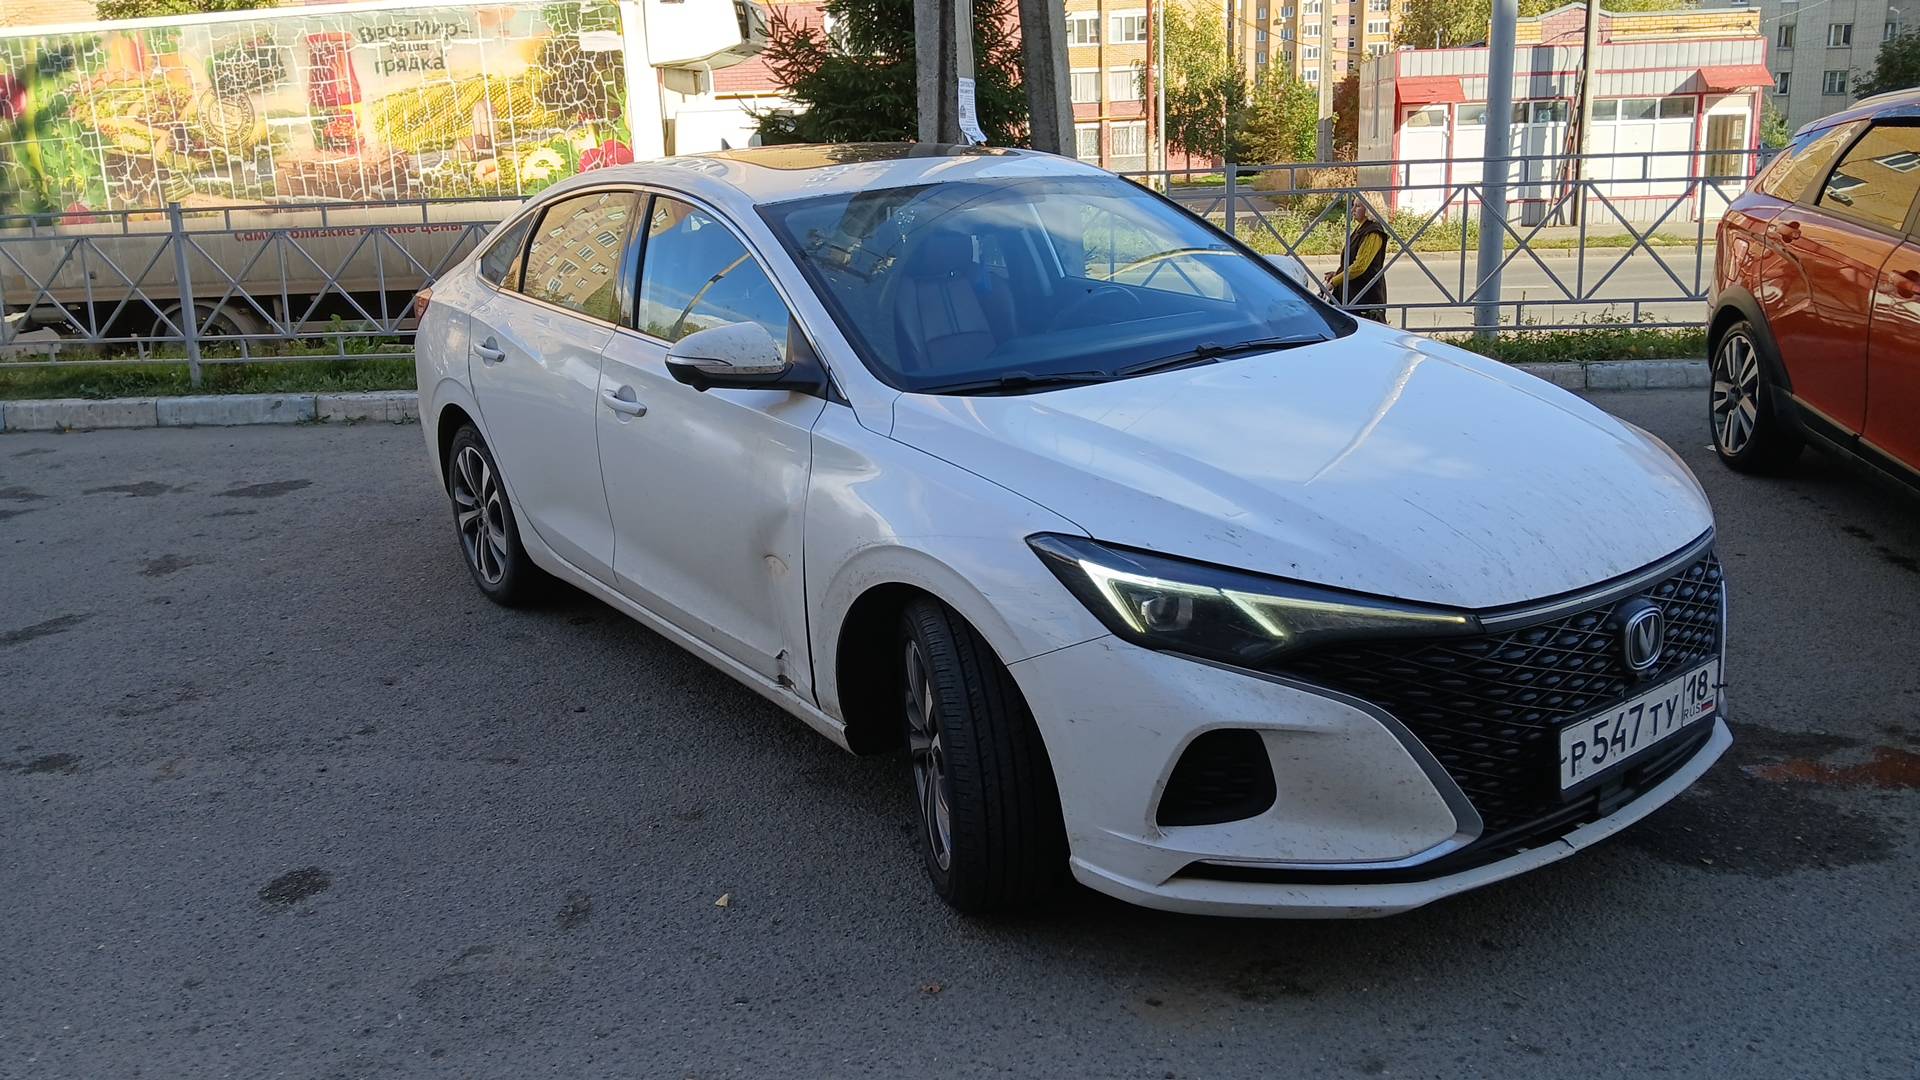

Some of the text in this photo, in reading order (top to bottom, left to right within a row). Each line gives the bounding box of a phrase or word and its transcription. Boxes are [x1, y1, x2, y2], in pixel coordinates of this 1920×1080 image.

[359, 25, 410, 43] Весь
[375, 54, 445, 77] грядка
[1686, 669, 1708, 705] 18
[1683, 703, 1701, 720] RUS
